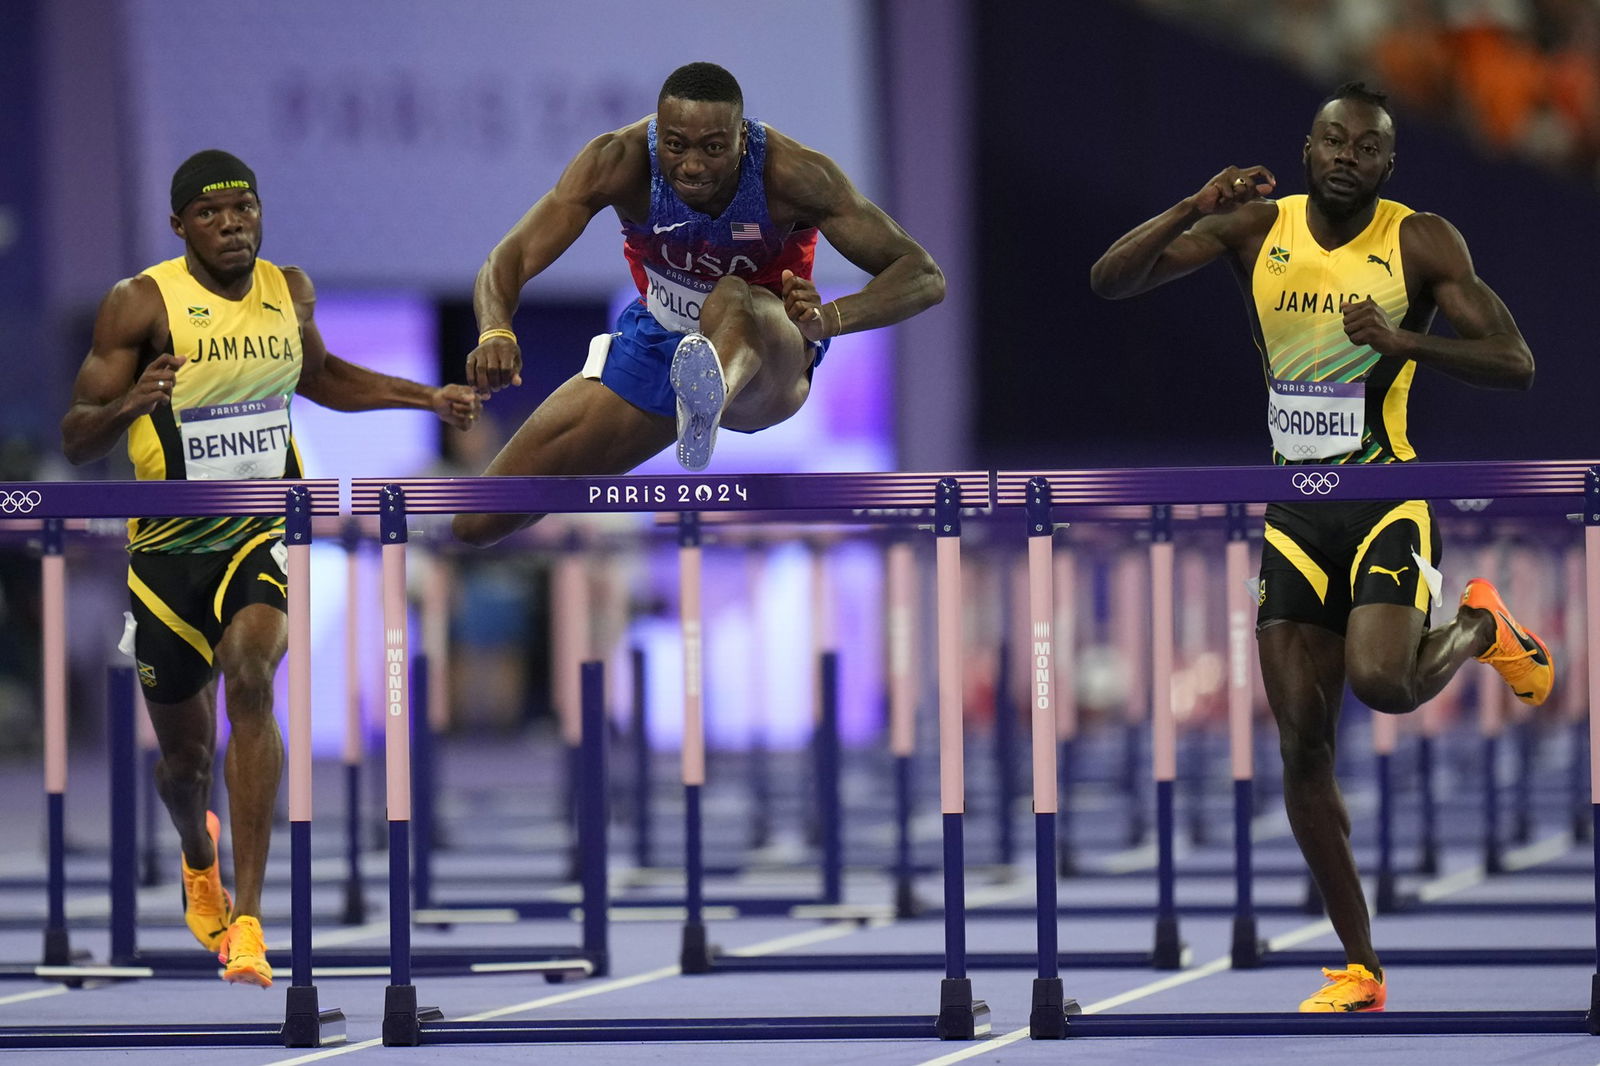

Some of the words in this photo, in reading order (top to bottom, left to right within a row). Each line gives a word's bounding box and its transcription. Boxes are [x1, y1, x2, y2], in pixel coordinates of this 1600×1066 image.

[661, 243, 758, 277] USA
[190, 335, 294, 363] JAMAICA
[1277, 383, 1305, 393] PARIS
[1308, 385, 1335, 394] 2024
[210, 405, 240, 417] PARIS
[241, 402, 267, 413] 2024
[1269, 401, 1359, 437] BROADBELL
[188, 424, 290, 461] BENNETT
[678, 483, 747, 502] 2024
[387, 648, 403, 716] MONDO
[1034, 641, 1050, 710] MONDO
